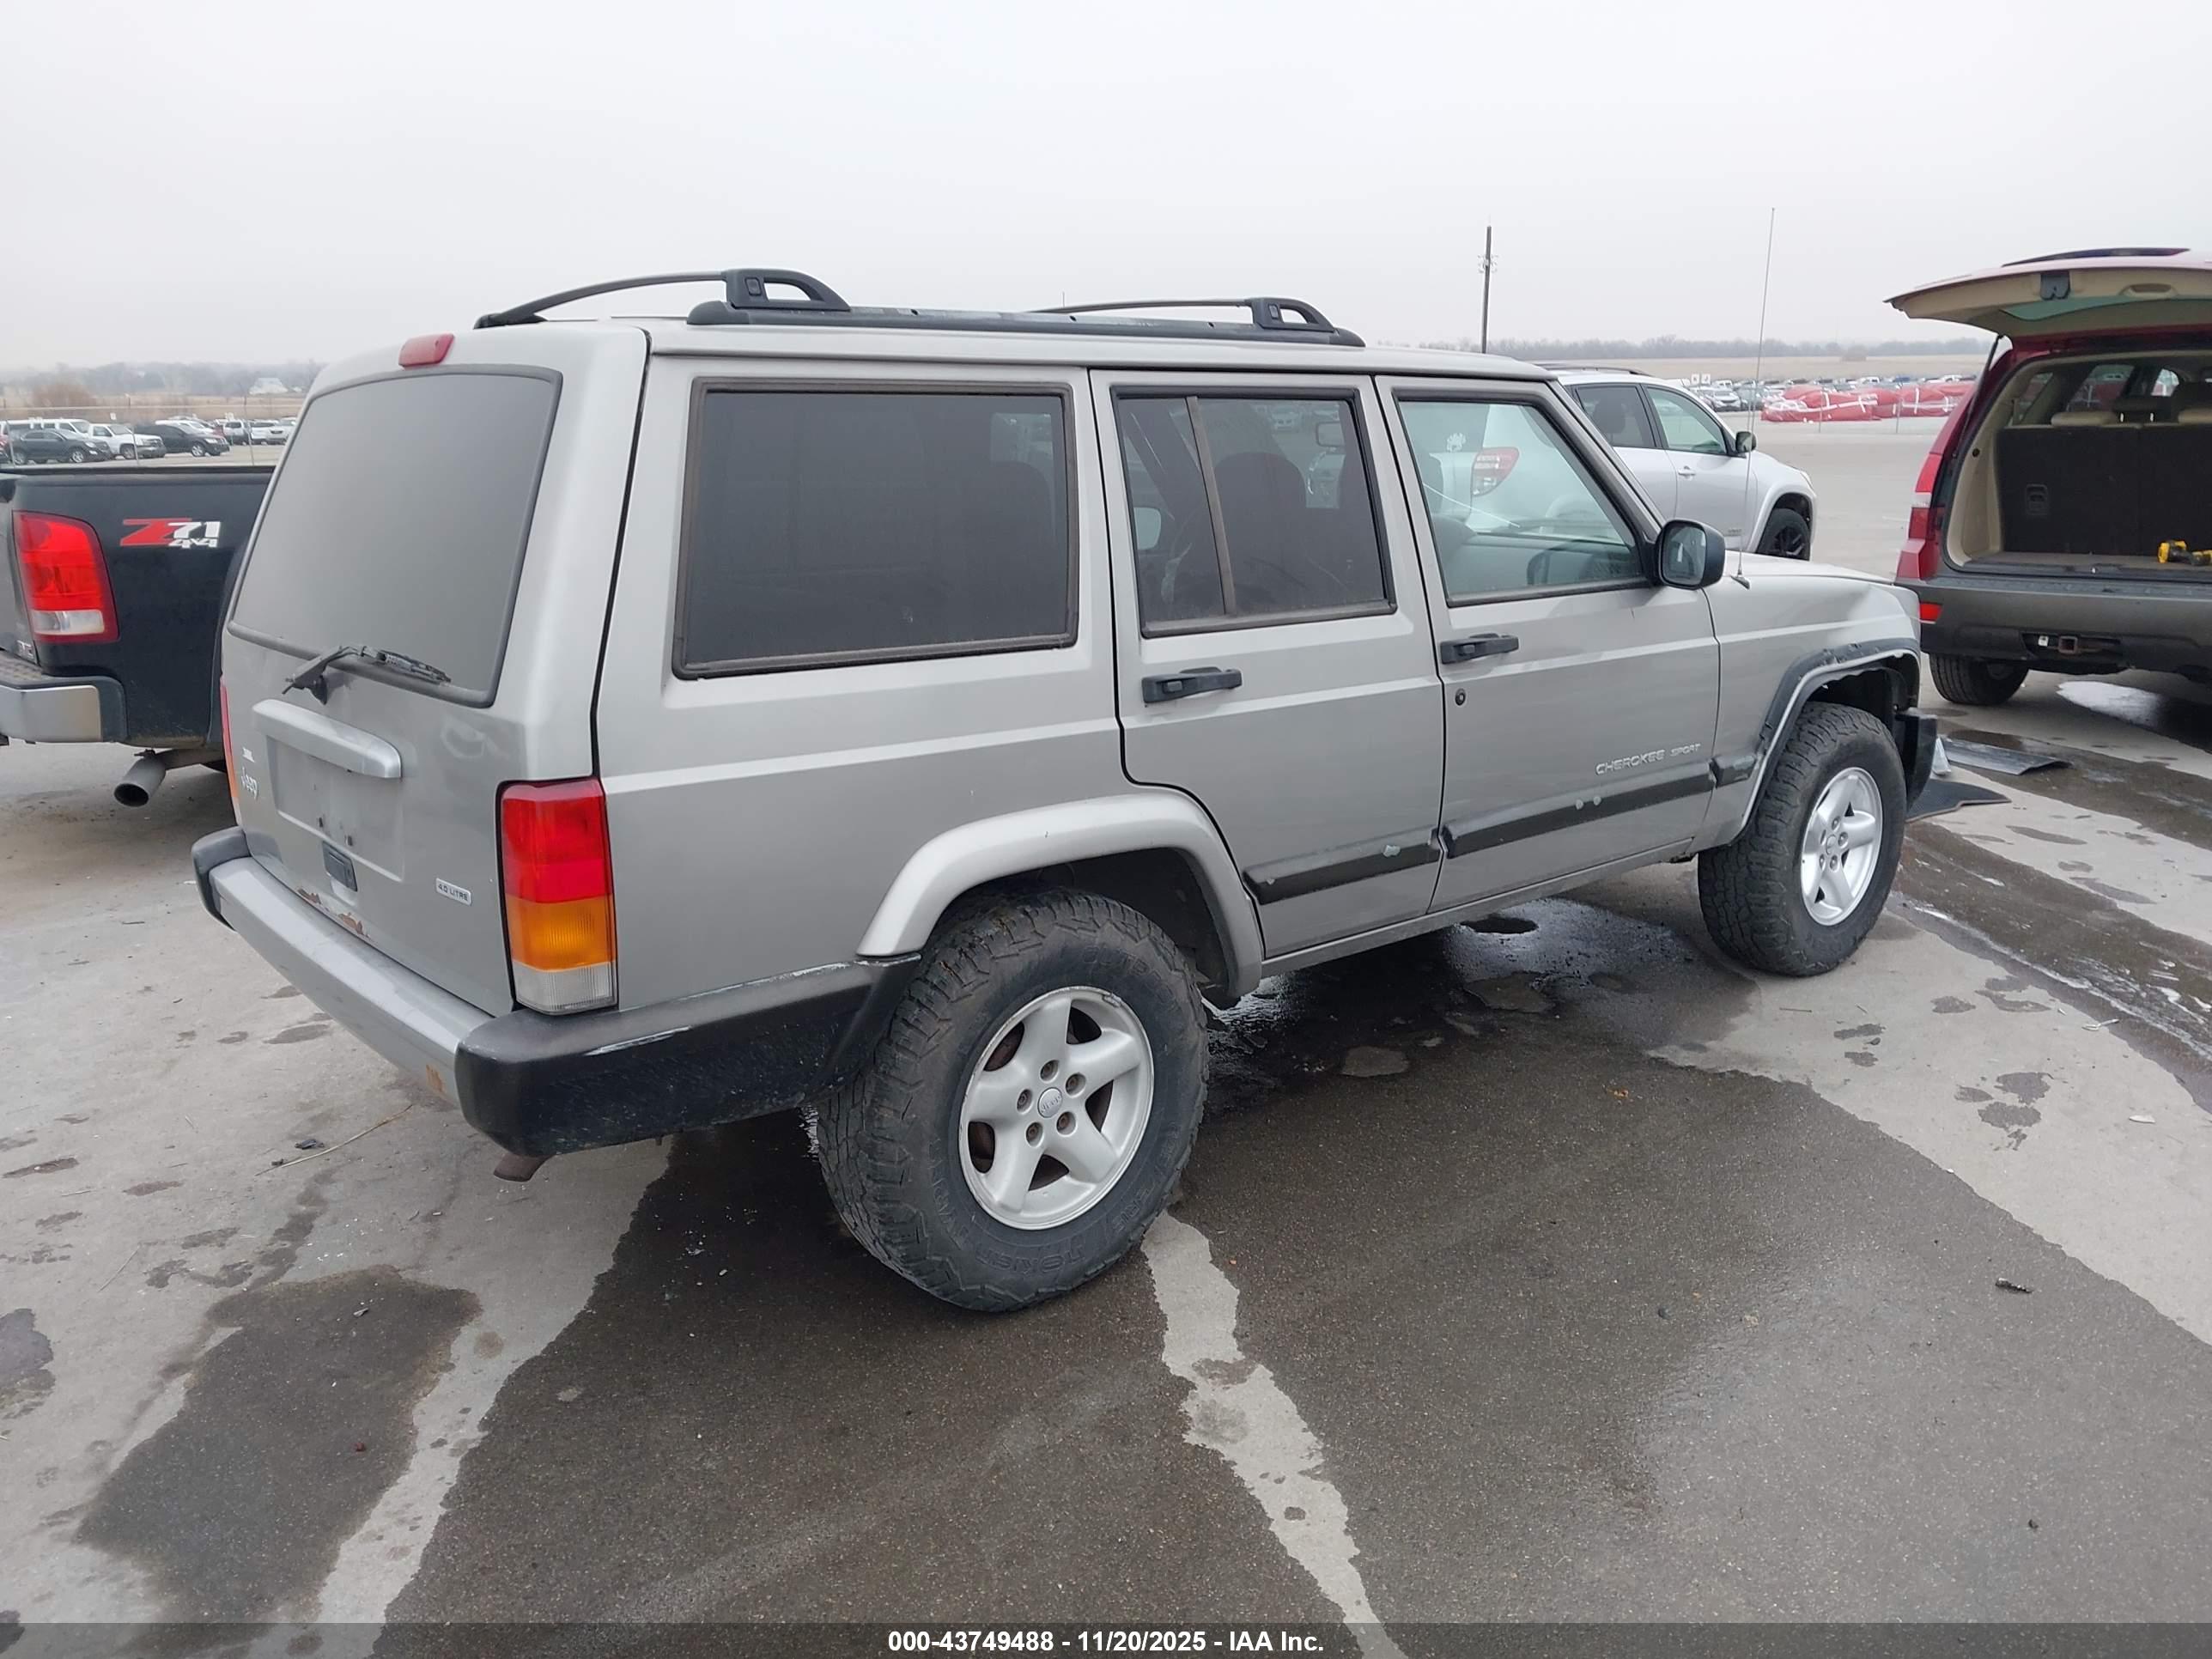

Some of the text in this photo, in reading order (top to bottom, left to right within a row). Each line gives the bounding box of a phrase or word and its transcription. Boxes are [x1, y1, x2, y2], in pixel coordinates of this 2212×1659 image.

[120, 518, 221, 545] Z71
[1595, 743, 1701, 775] CHEROKEE SPORT
[241, 766, 258, 800] Jeep
